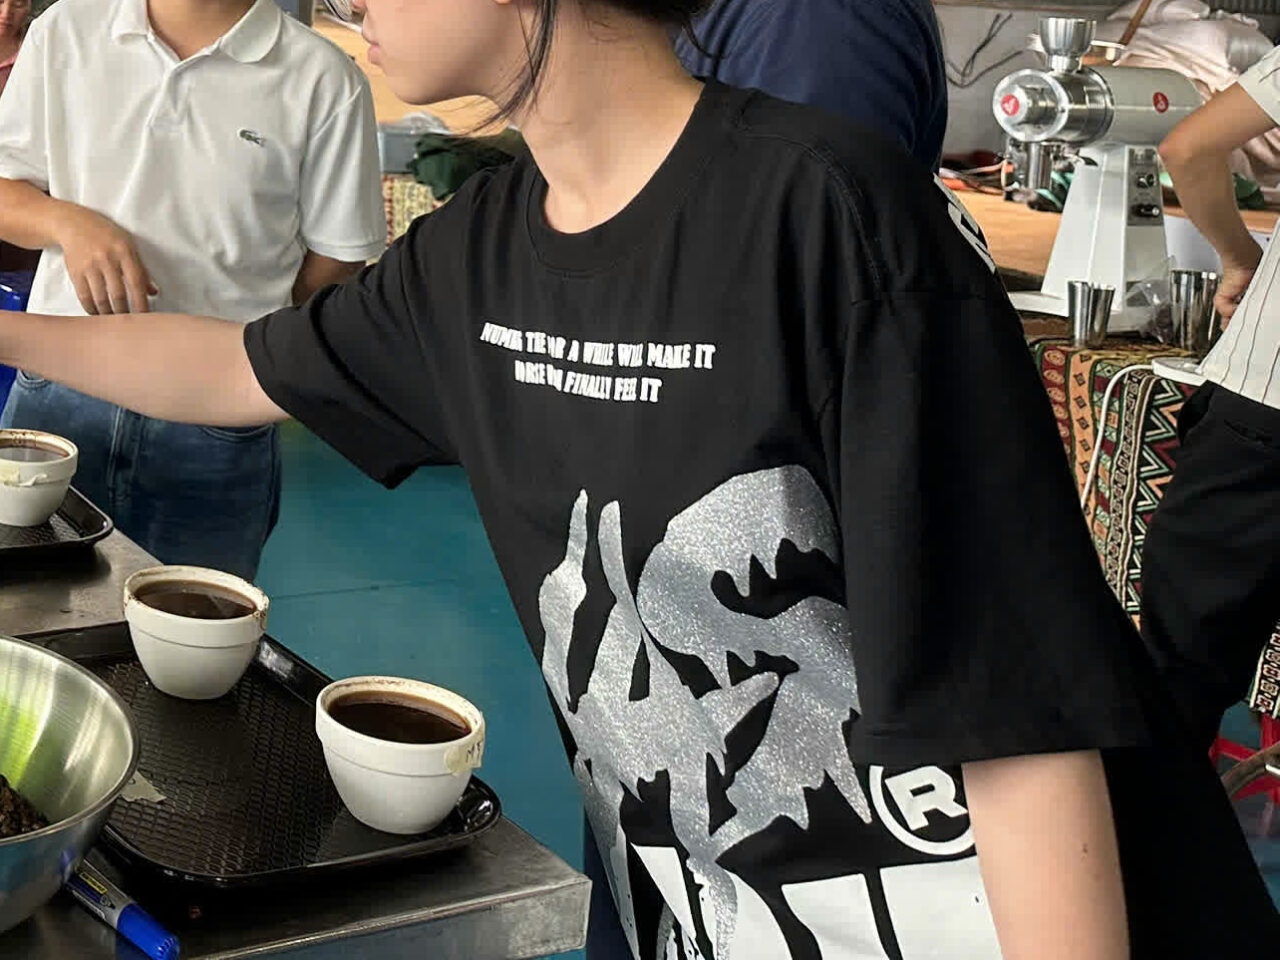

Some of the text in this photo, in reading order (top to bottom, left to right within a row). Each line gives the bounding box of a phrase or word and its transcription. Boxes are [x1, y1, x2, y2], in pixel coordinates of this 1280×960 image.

[567, 339, 579, 362] A
[694, 343, 716, 369] IT
[639, 377, 662, 402] IT
